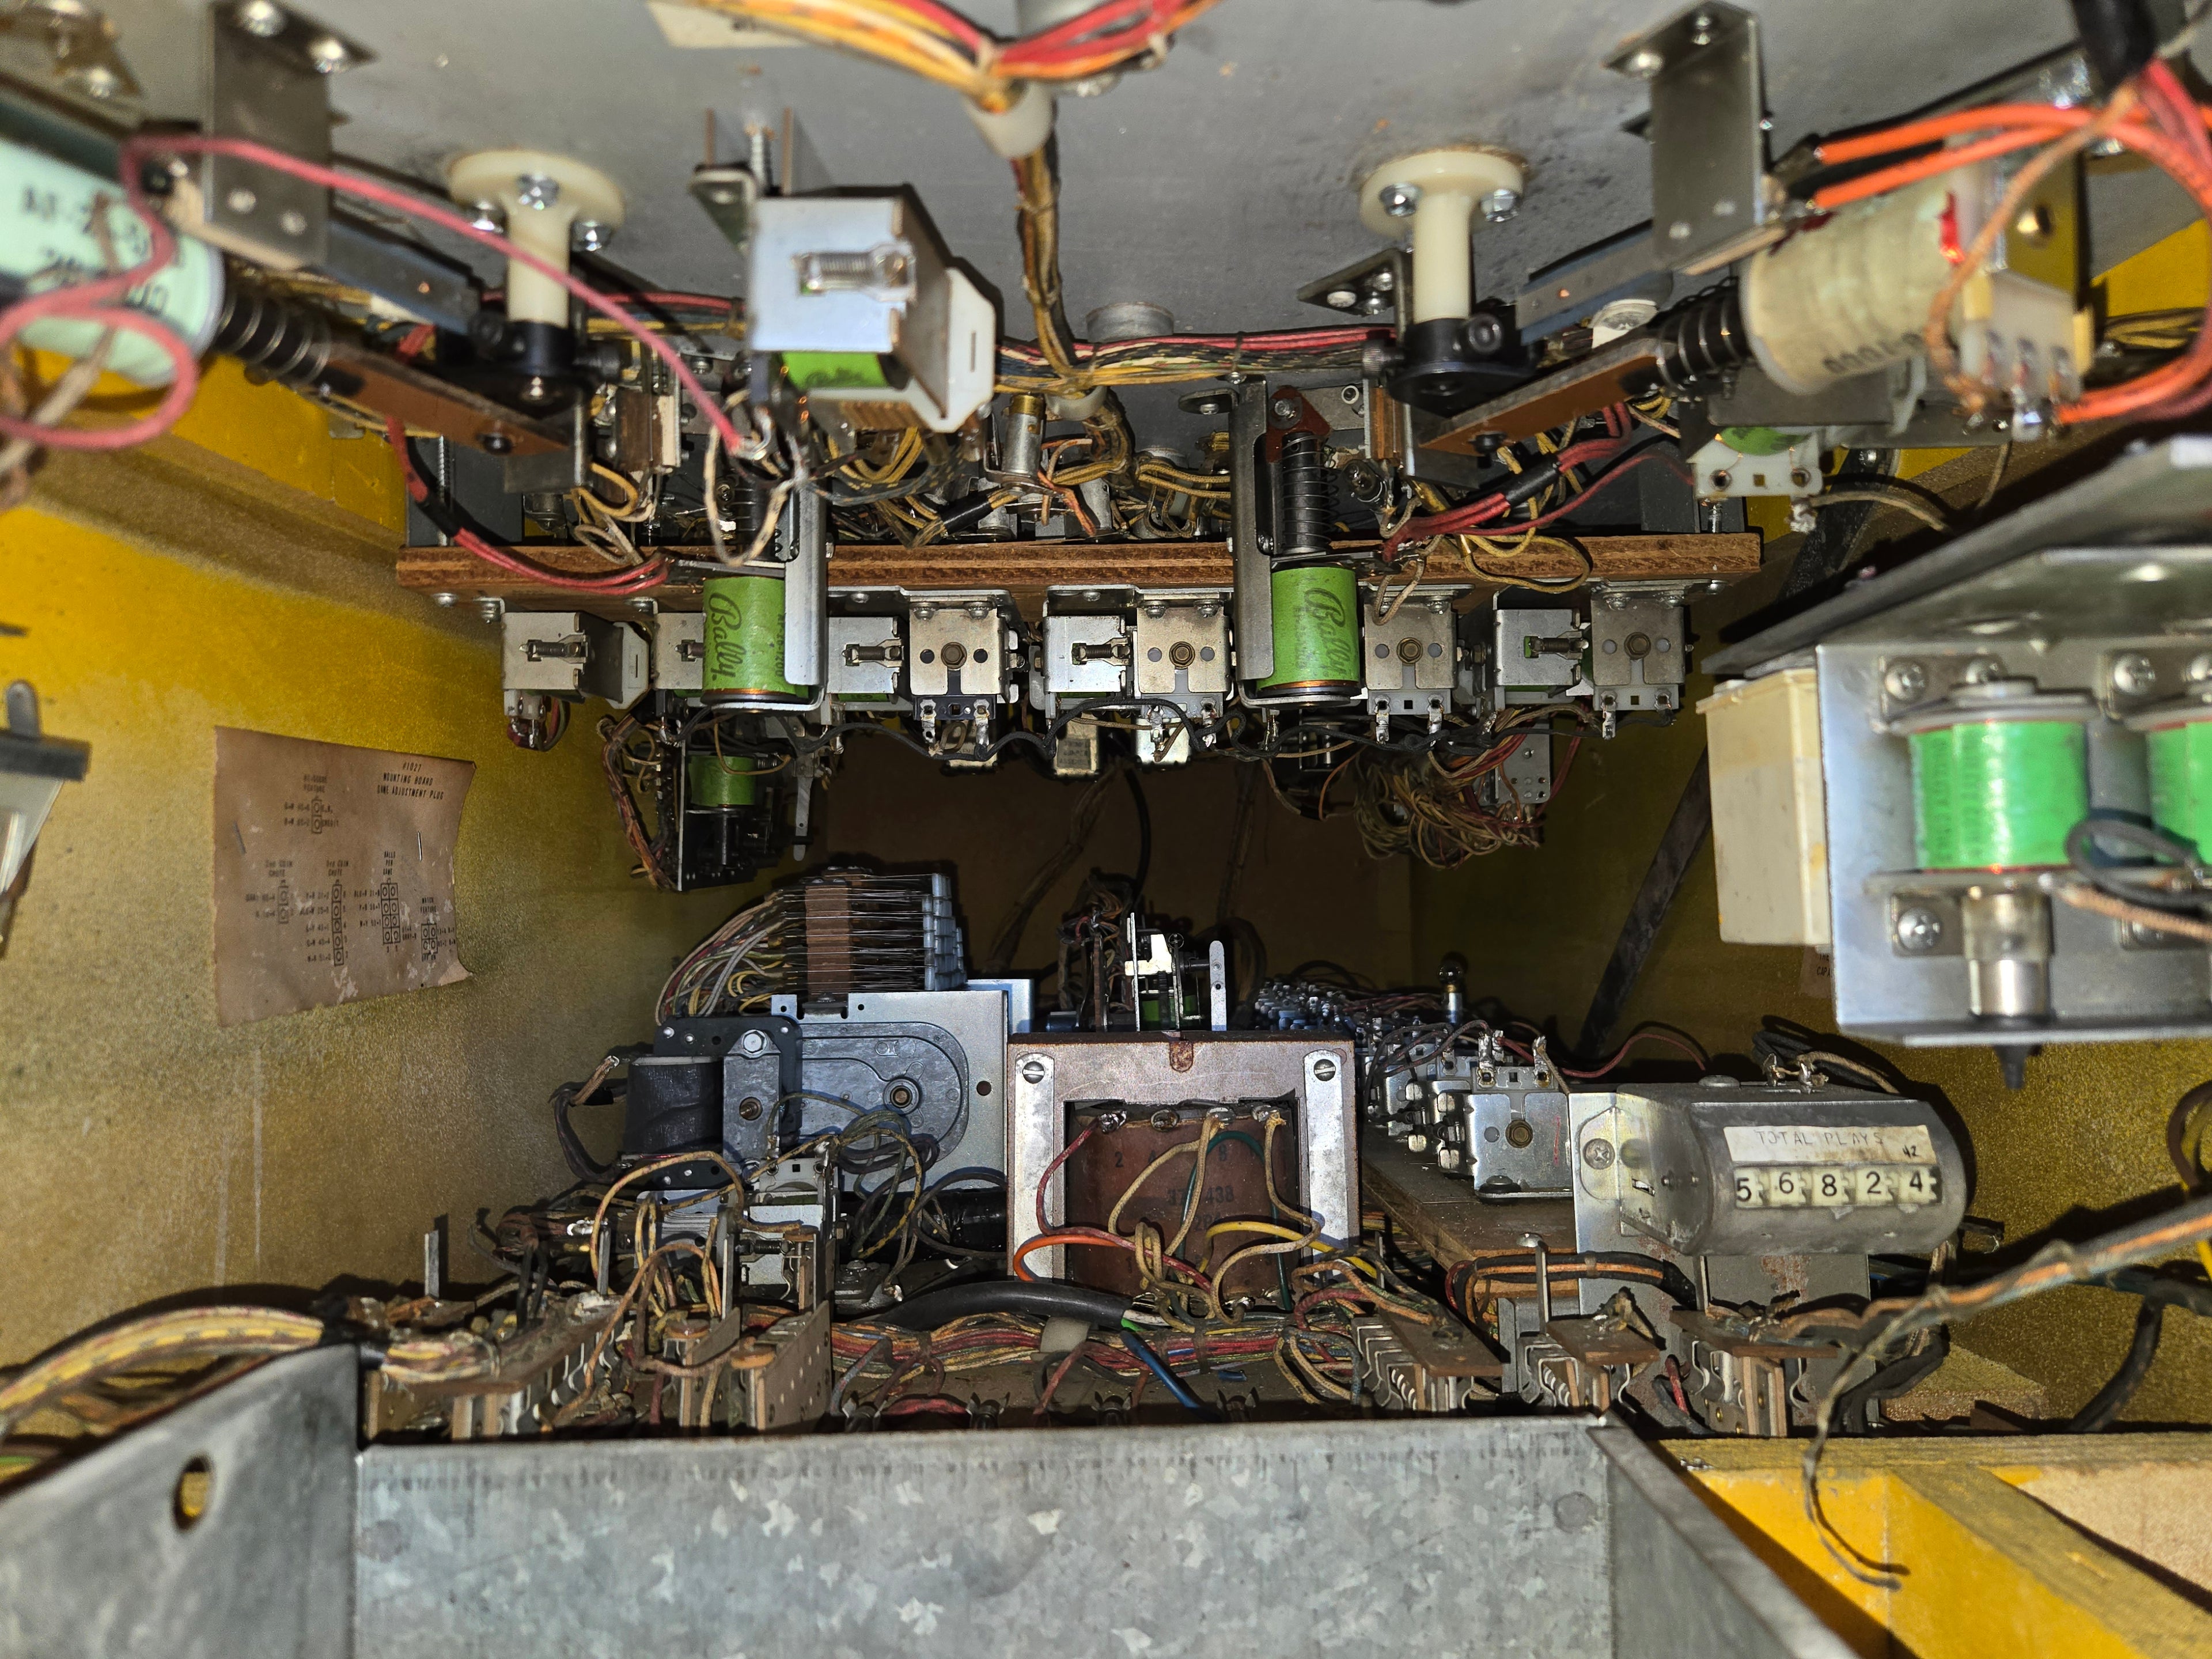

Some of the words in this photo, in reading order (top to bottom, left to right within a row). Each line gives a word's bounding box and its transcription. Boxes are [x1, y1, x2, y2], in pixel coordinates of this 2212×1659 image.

[709, 593, 747, 677] Bally
[1304, 588, 1351, 675] Bally
[402, 762, 422, 772] #1027
[383, 772, 411, 784] MOUNTING
[414, 775, 433, 786] BOARD
[377, 785, 389, 794] GAME
[392, 787, 427, 798] ADJUSTMENT
[429, 790, 444, 800] PLUG
[1754, 1130, 1813, 1145] TOTAL
[1824, 1131, 1884, 1146] PLAYS
[1115, 1151, 1124, 1168] 2
